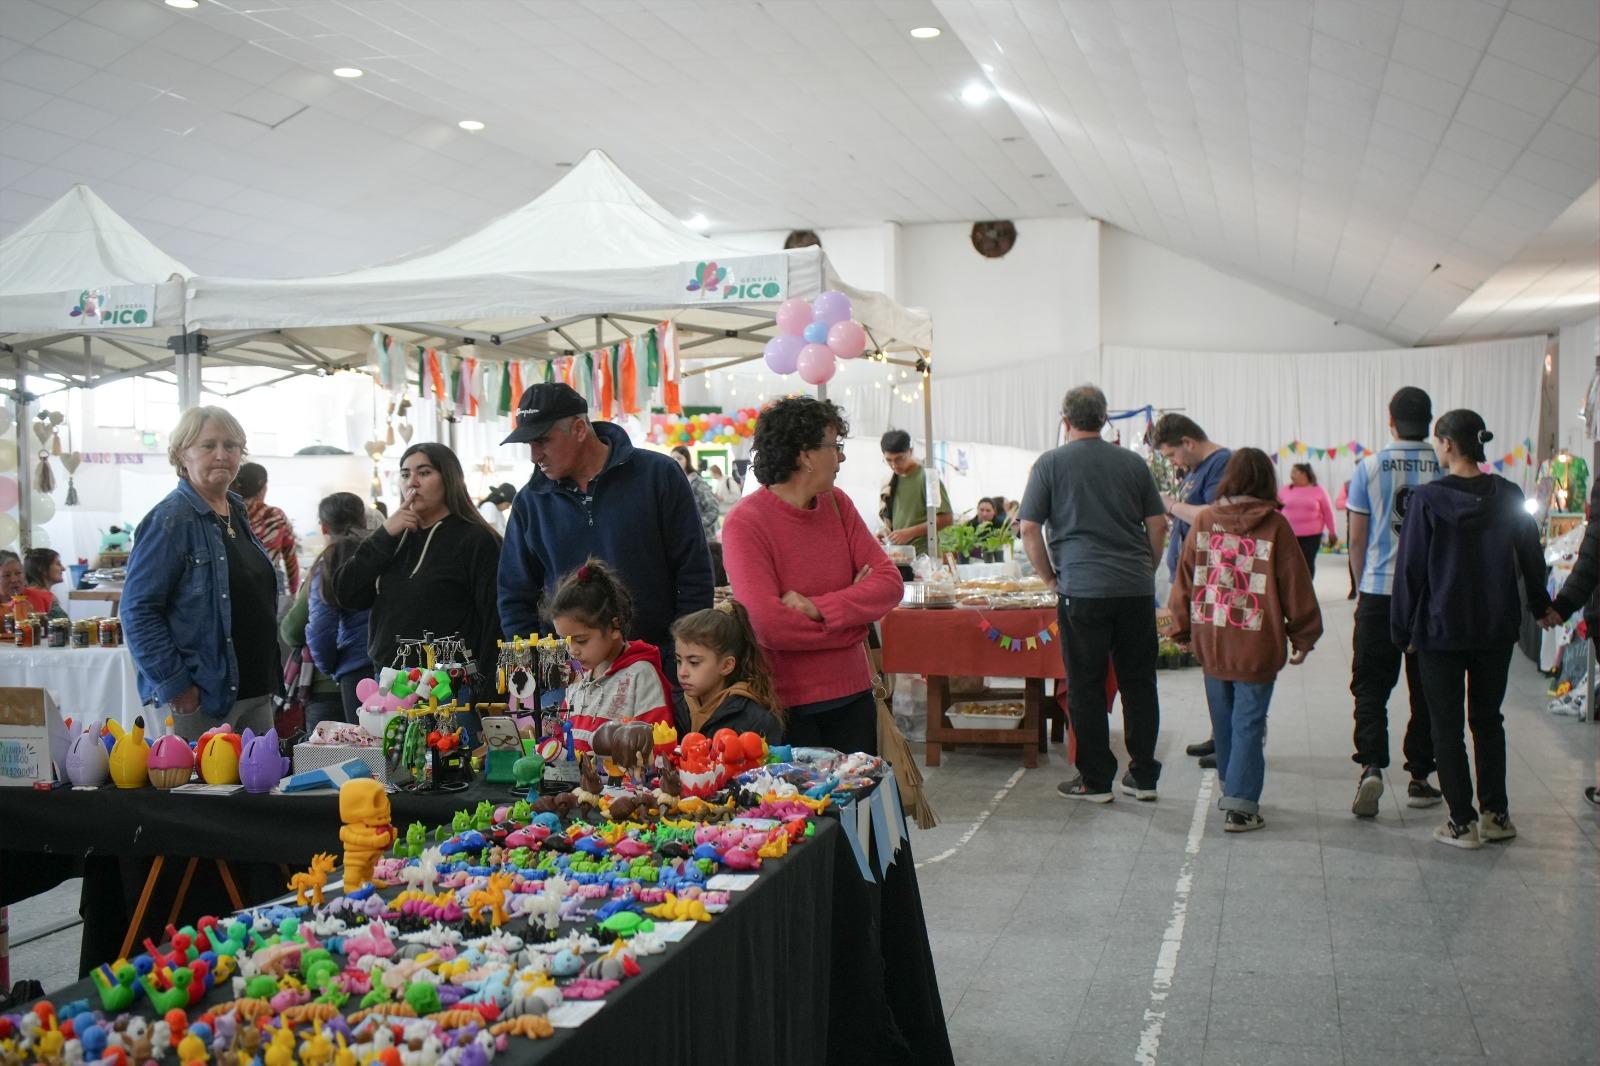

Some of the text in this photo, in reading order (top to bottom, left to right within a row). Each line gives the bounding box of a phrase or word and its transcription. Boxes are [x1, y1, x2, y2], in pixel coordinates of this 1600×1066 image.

[723, 282, 780, 299] PICO
[100, 309, 148, 324] PICO
[1382, 460, 1440, 473] BATISTUTA
